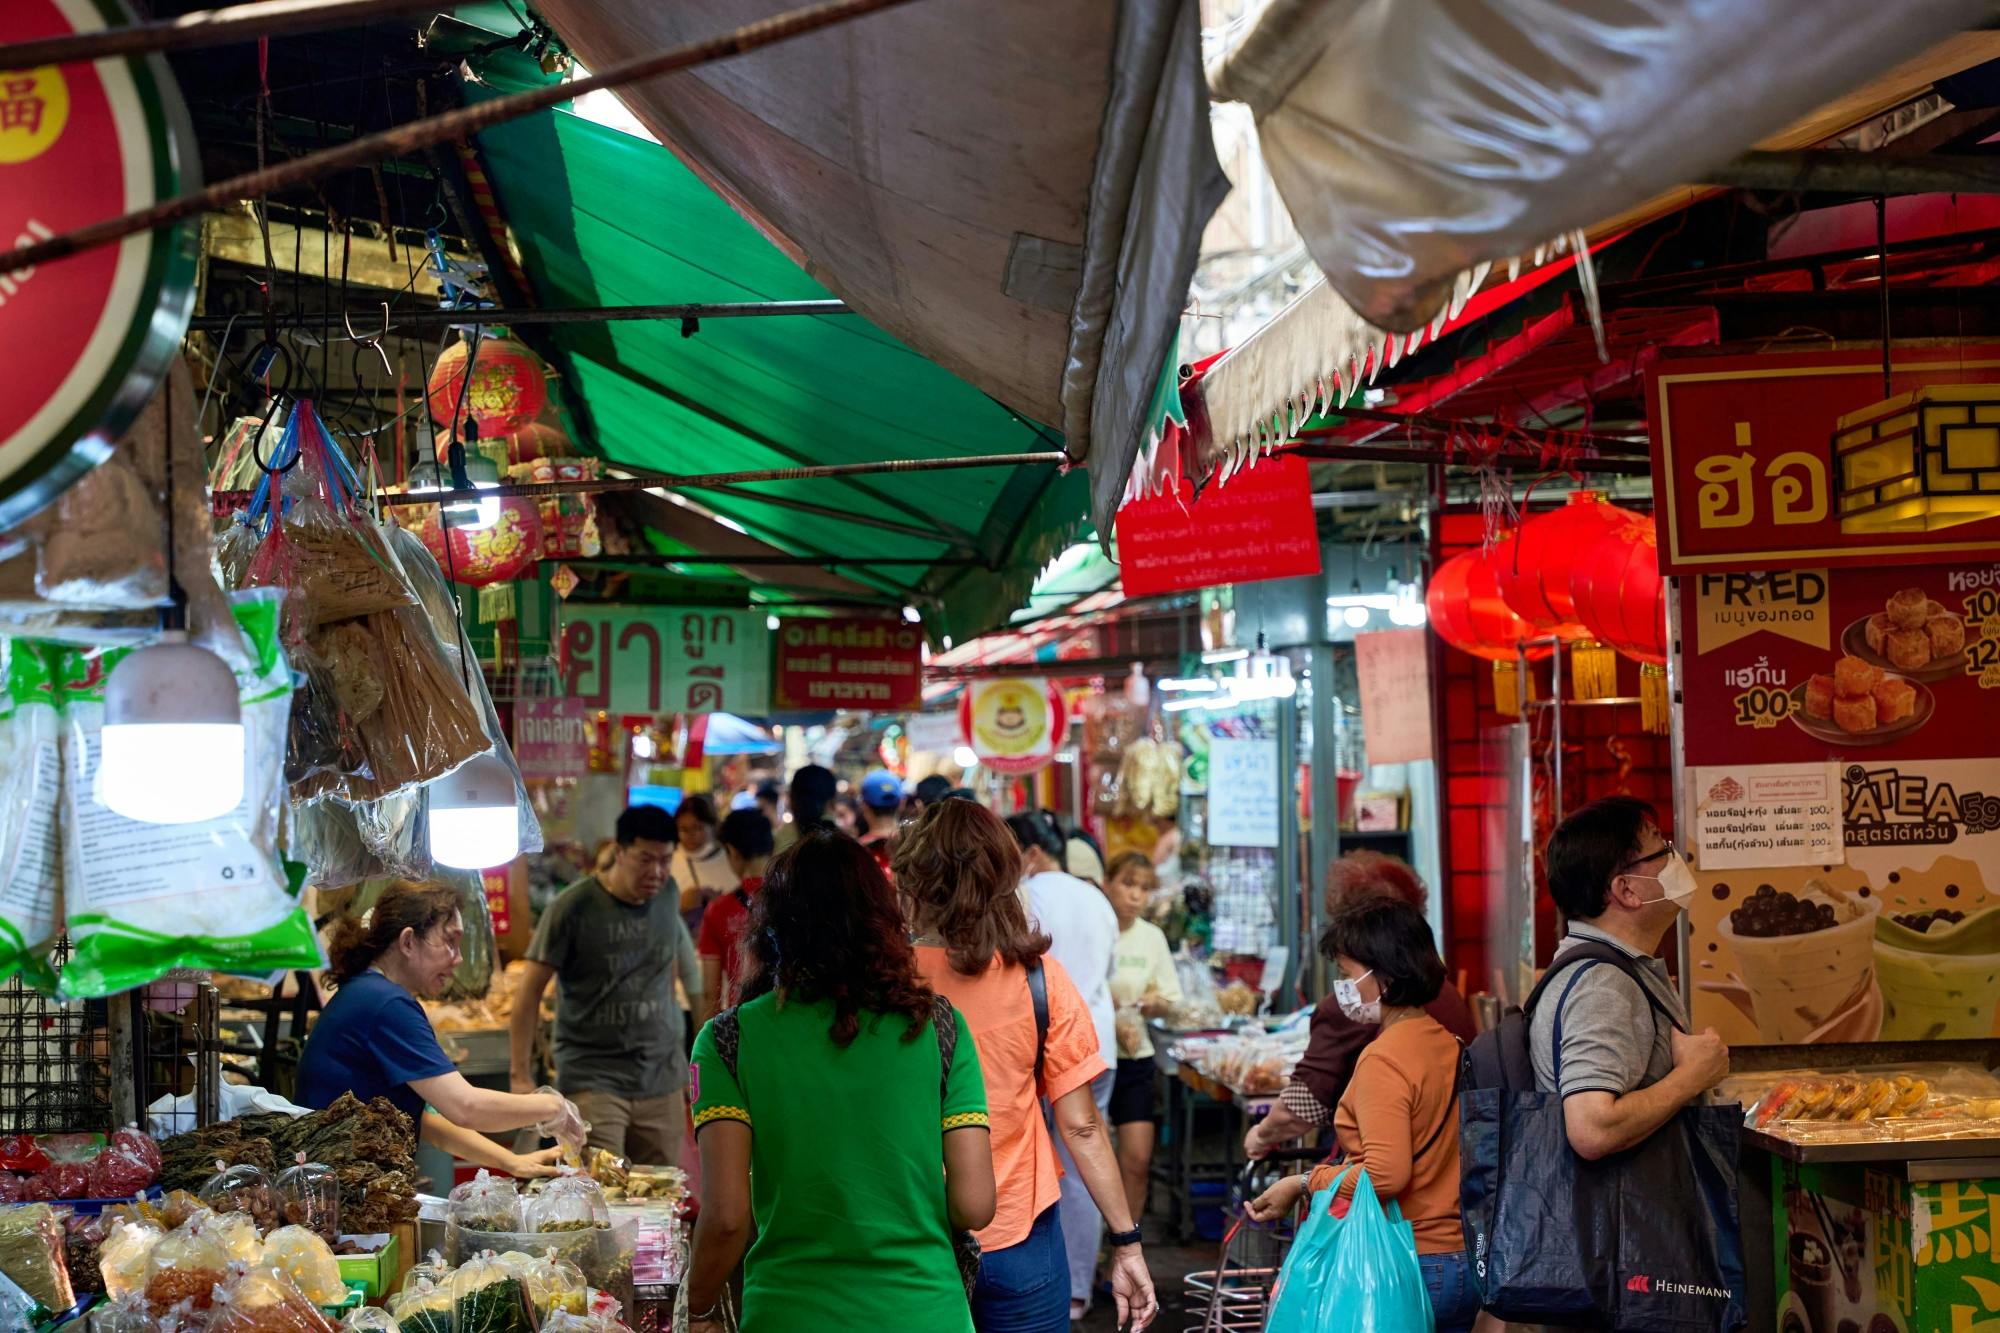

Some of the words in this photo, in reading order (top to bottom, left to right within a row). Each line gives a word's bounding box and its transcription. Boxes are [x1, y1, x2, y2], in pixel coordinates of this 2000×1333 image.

[1965, 590, 2000, 624] 10
[682, 613, 735, 660] ถูก
[1965, 639, 2000, 673] 12
[686, 665, 726, 711] ดี
